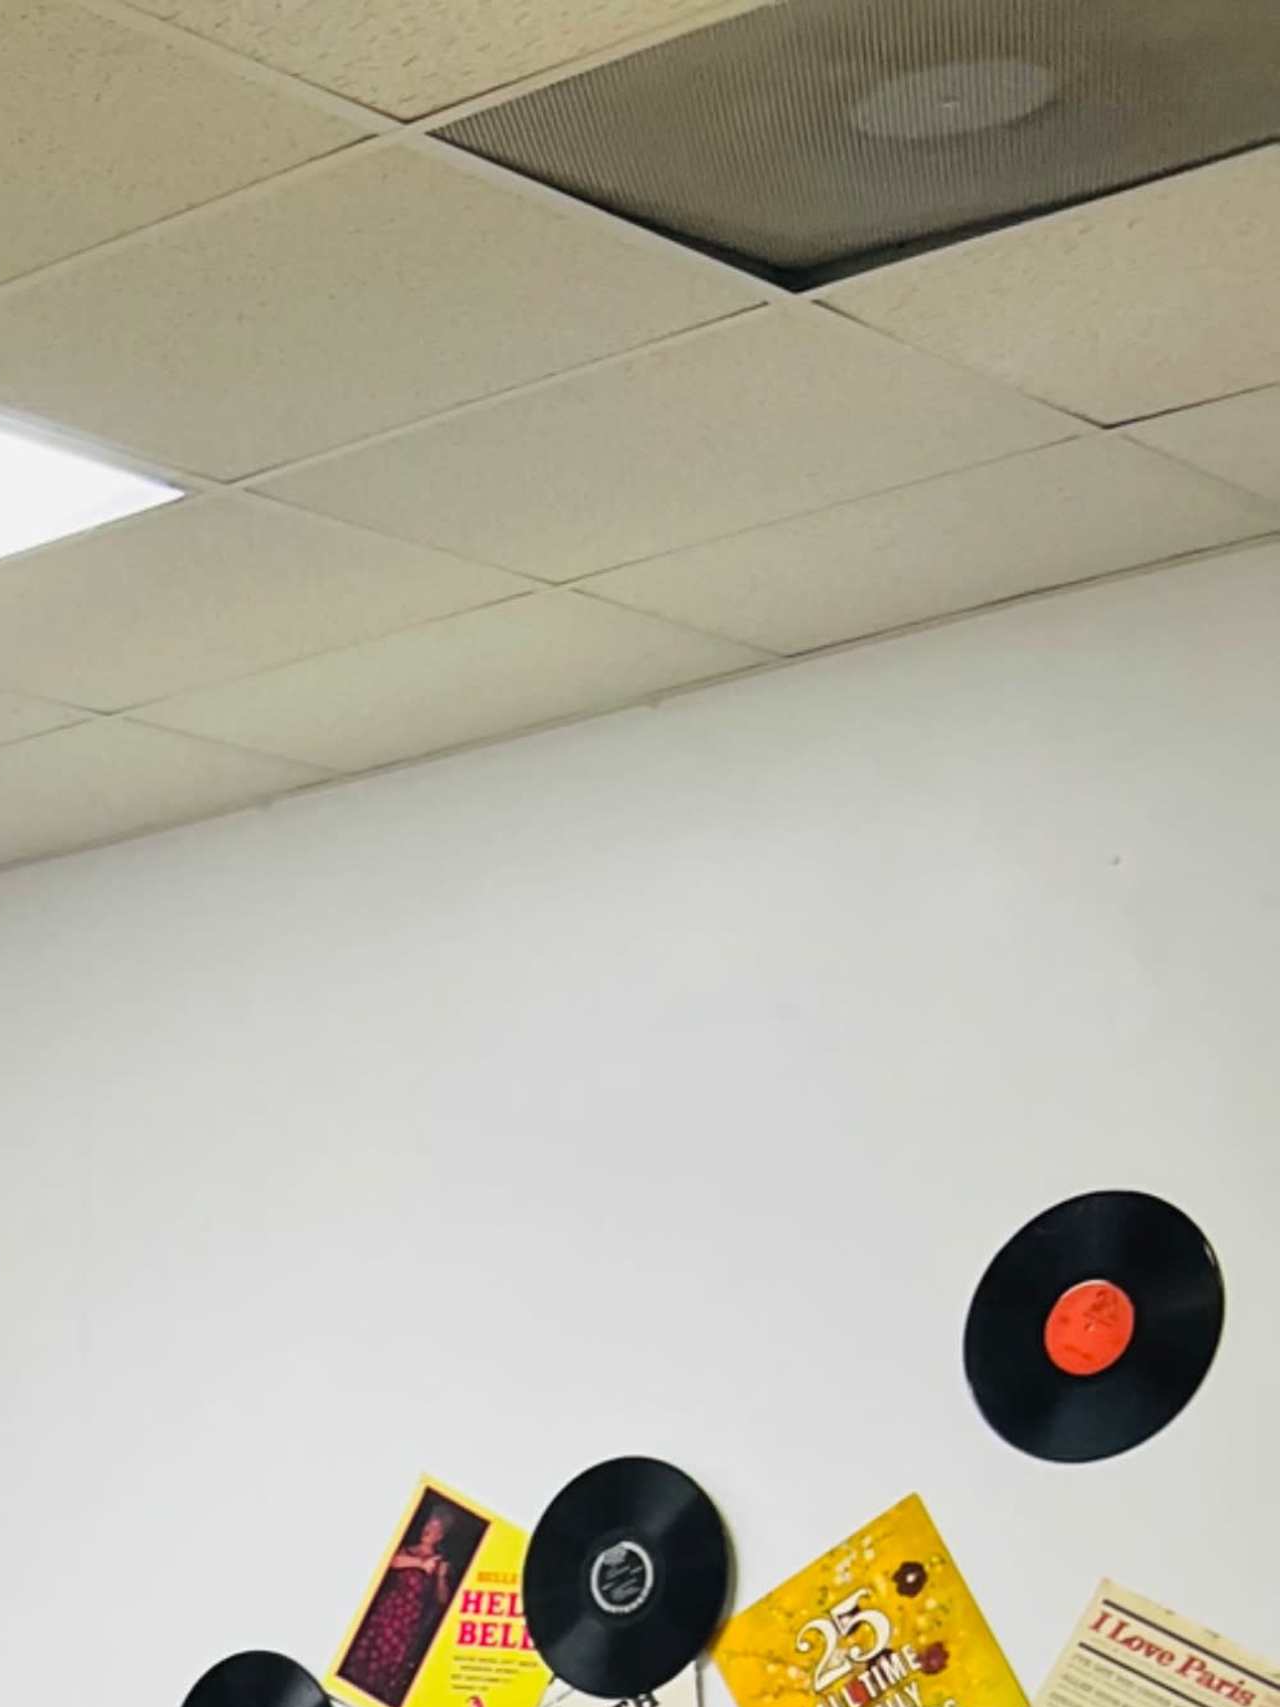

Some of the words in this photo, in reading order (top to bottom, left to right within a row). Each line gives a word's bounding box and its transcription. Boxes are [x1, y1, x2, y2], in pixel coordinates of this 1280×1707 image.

[459, 1590, 527, 1618] HEL
[795, 1587, 892, 1694] 25
[856, 1643, 924, 1699] TIME
[1088, 1609, 1114, 1633] I
[1107, 1618, 1177, 1667] Love
[1175, 1652, 1258, 1707] Paris
